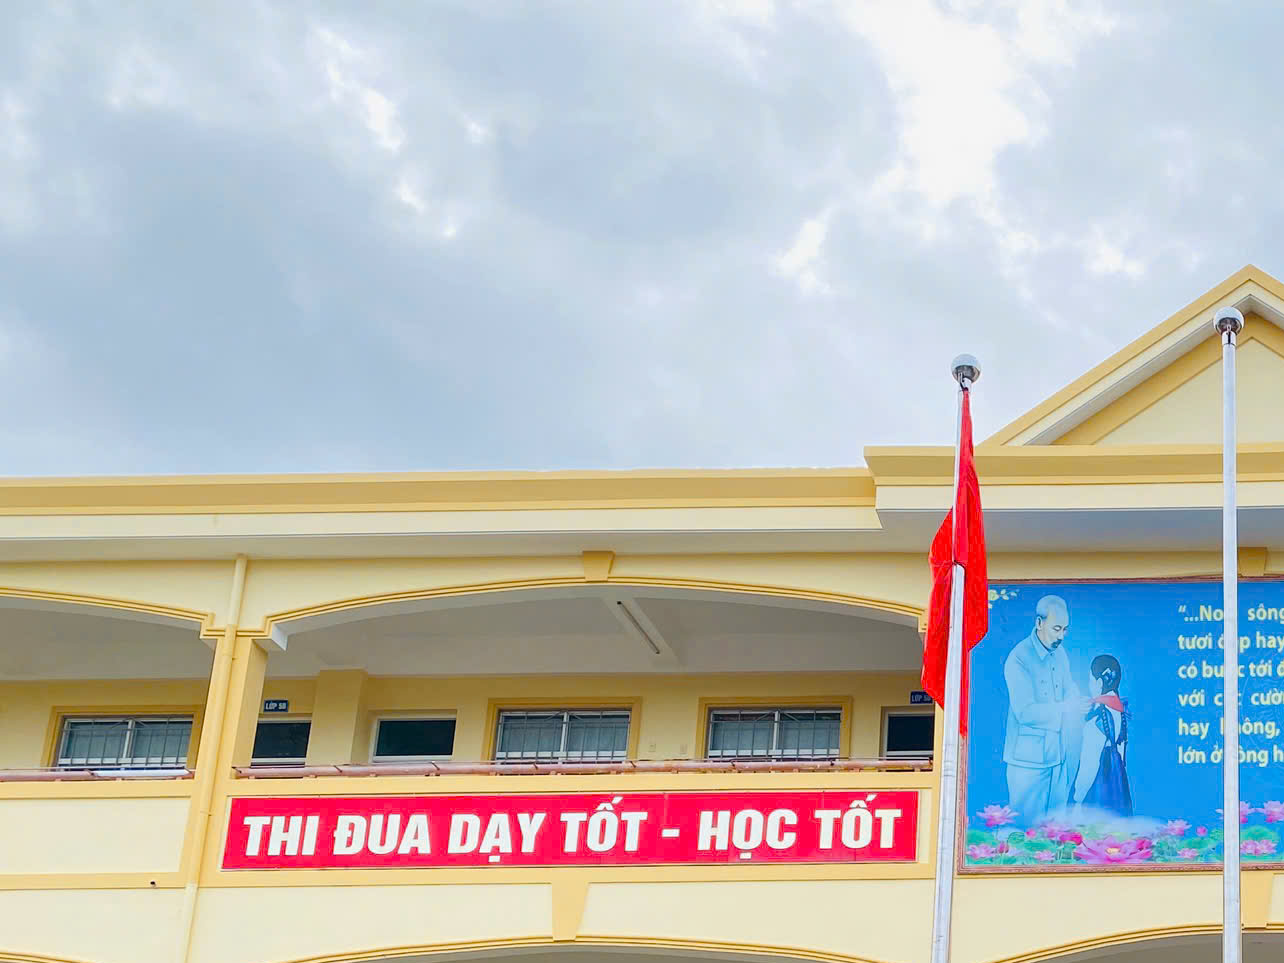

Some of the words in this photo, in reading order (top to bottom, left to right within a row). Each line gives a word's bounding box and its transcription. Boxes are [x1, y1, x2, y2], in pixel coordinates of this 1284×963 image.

[1178, 632, 1213, 650] tươi
[1178, 660, 1198, 679] có
[1249, 660, 1273, 677] tới
[1178, 688, 1205, 707] với
[1178, 718, 1210, 740] hay
[1178, 746, 1206, 764] lớn
[1210, 743, 1223, 764] ở
[243, 815, 319, 857] THI
[333, 813, 431, 856] ĐUA
[448, 812, 546, 863] DẠY
[560, 796, 648, 853] TỐT
[661, 828, 680, 838] -
[697, 808, 798, 860] HỌC
[814, 793, 902, 849] TỐT
